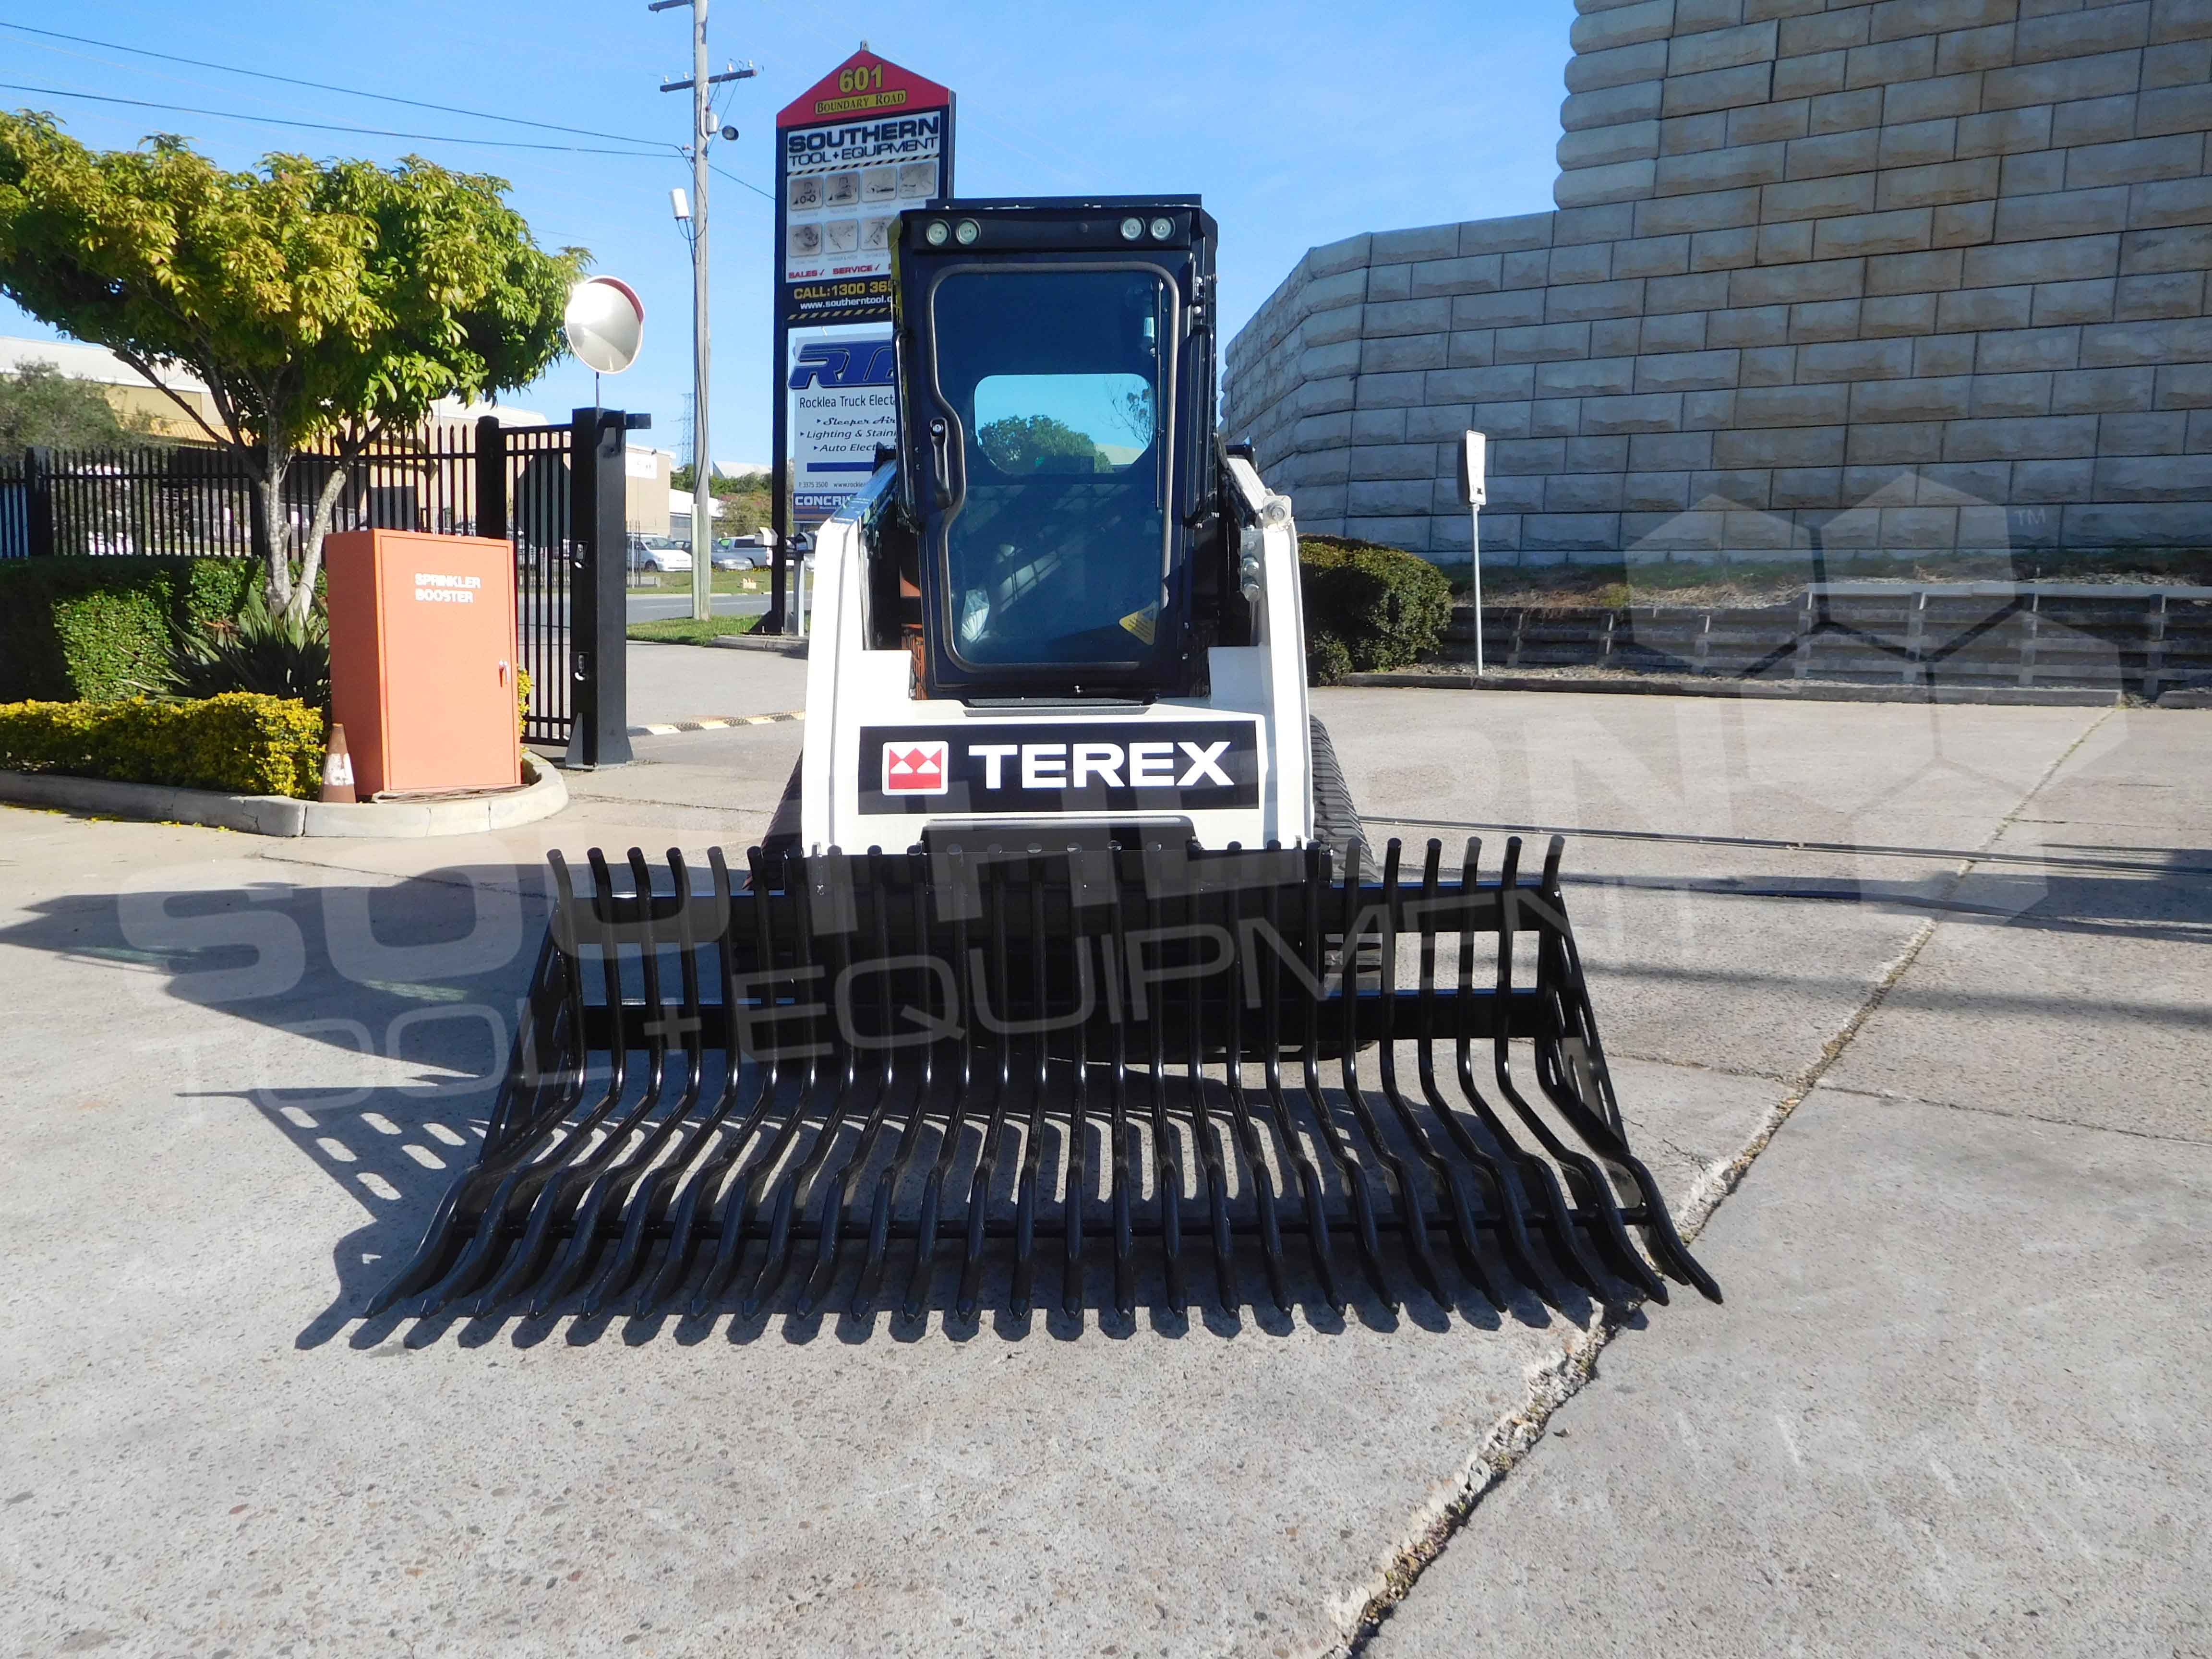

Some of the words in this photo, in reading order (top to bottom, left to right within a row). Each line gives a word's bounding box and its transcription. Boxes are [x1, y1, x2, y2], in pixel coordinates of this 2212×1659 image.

[838, 63, 883, 93] 601
[788, 116, 939, 153] SOUTHERN
[789, 270, 817, 278] SALES
[833, 264, 872, 275] SERVICE
[800, 396, 836, 408] Rocklea
[840, 395, 866, 407] Truck
[823, 417, 869, 426] Sleeper
[806, 431, 852, 440] Lighting
[415, 574, 481, 589] SPRINKLER
[415, 589, 473, 602] BOOSTER
[968, 741, 1235, 789] TEREX
